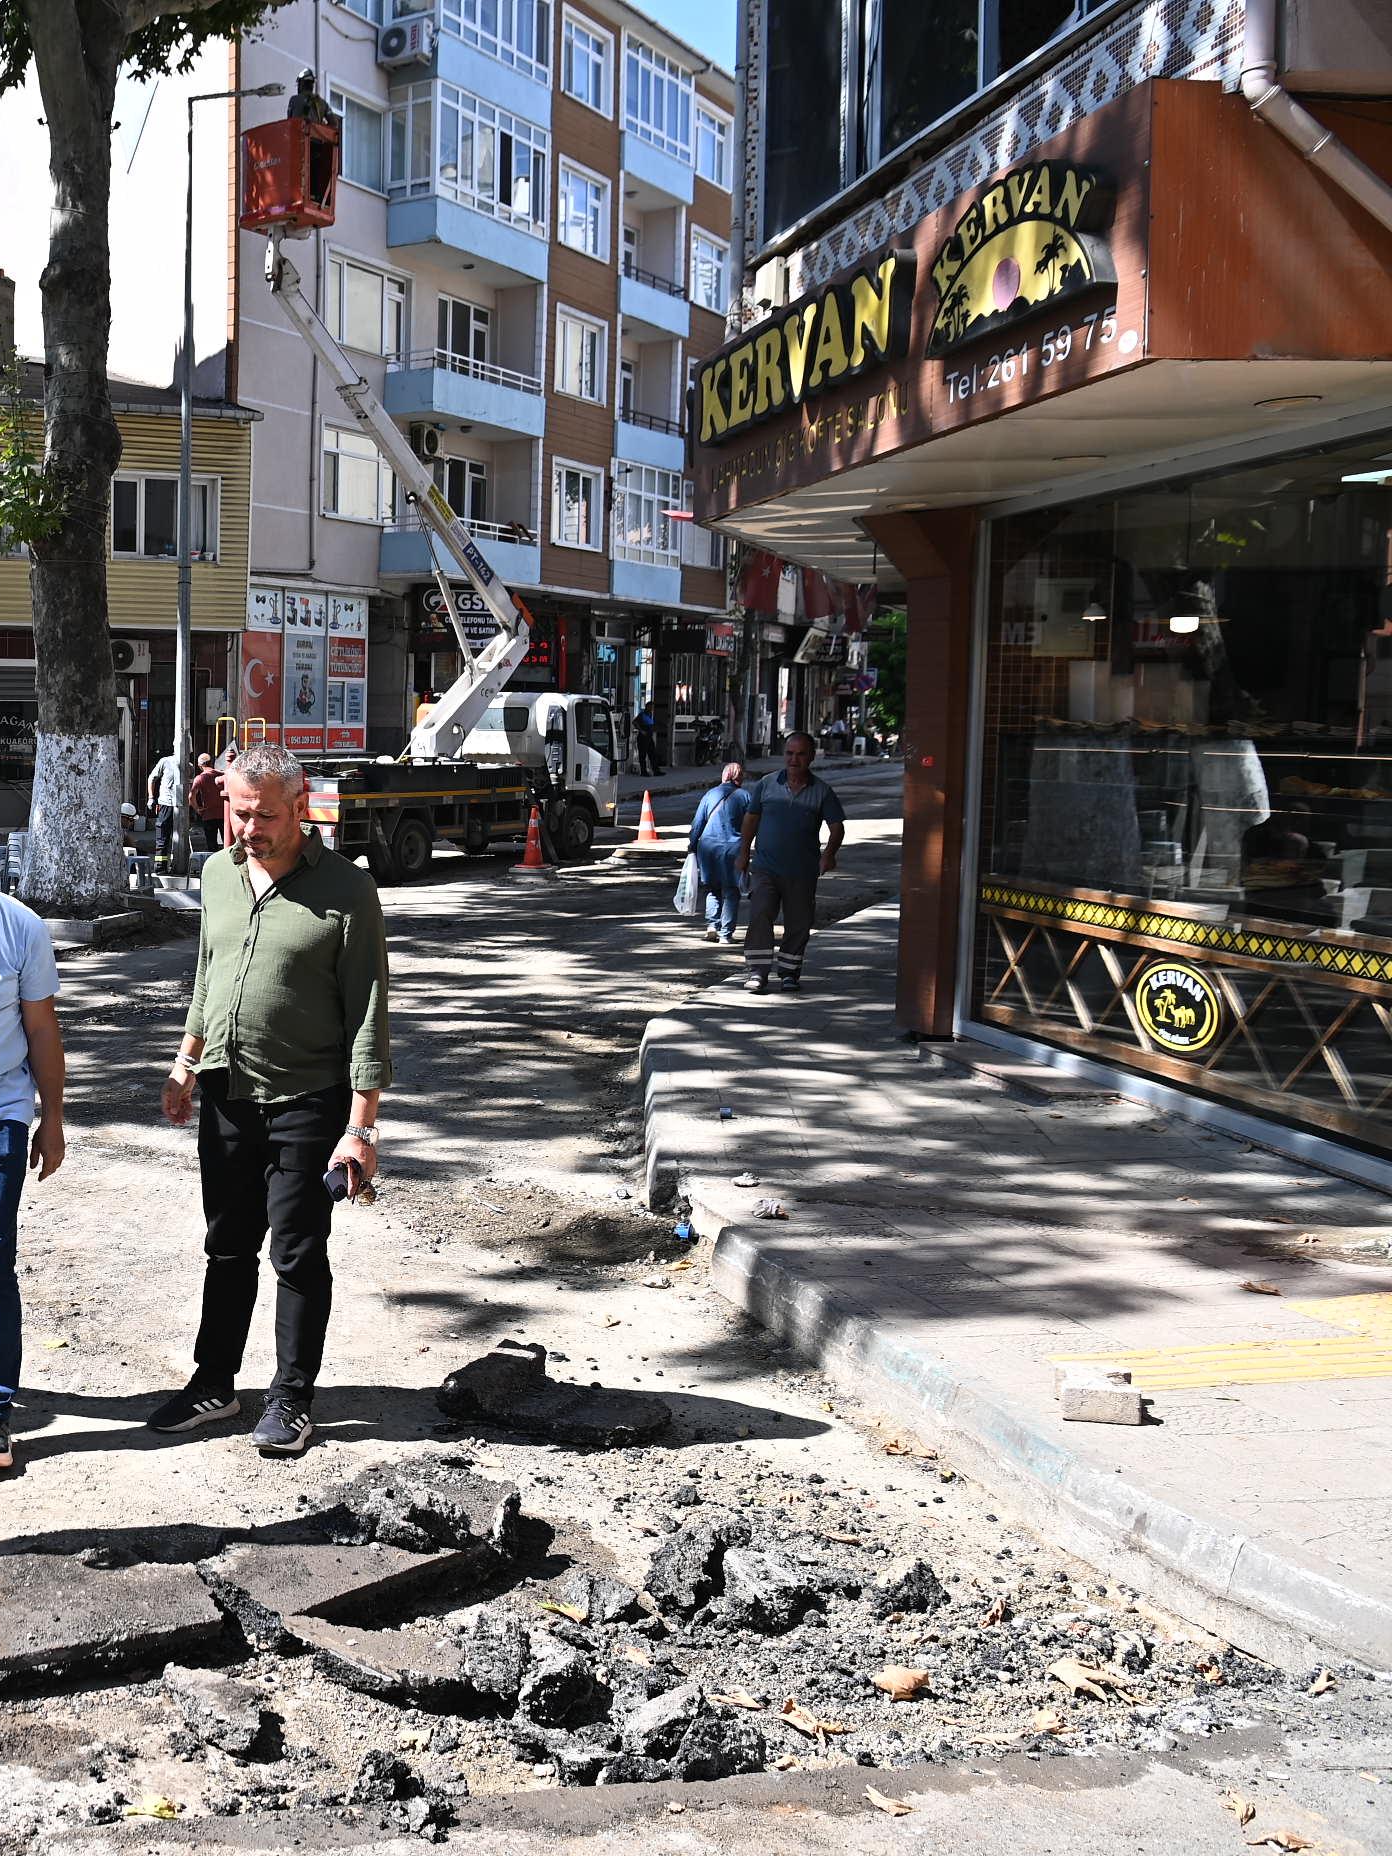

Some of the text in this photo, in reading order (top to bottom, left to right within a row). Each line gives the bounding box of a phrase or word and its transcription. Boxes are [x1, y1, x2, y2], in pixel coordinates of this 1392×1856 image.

[932, 165, 1091, 298] KERVAN
[699, 257, 896, 442] KERVAN
[1041, 325, 1072, 367] 59
[1083, 306, 1117, 350] 75
[458, 593, 490, 610] GS
[460, 617, 486, 626] ELEFONU
[1148, 970, 1205, 1002] KERVAN
